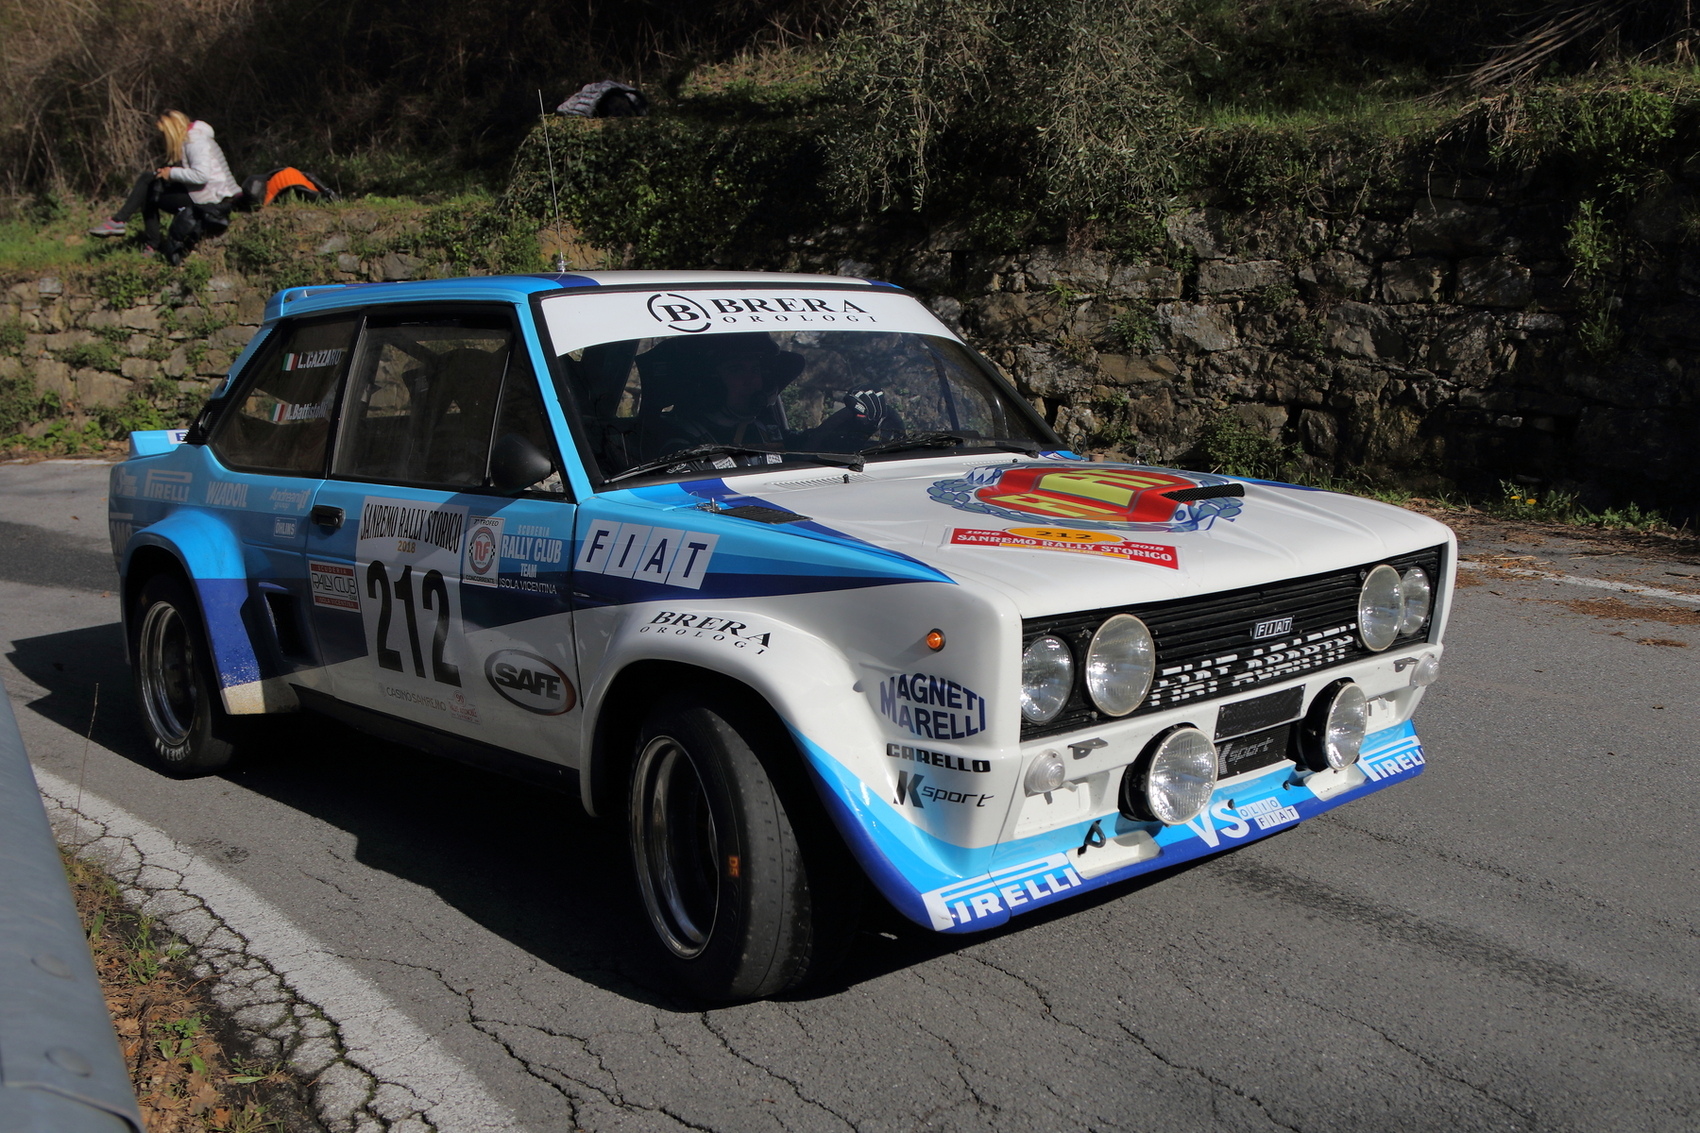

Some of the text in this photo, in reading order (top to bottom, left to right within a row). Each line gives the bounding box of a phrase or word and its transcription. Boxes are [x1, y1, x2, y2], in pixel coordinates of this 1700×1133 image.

[657, 304, 700, 323] B
[710, 297, 868, 314] BRERA
[722, 314, 878, 324] OROLOGI
[143, 469, 193, 502] PIRELLI
[361, 503, 463, 554] SANREMO RALLY STORICO
[517, 524, 551, 537] SCUDERIA
[1036, 530, 1093, 540] 212
[397, 540, 416, 554] 2018
[501, 535, 563, 564] RALLY CLUB
[585, 529, 708, 578] FIAT
[957, 534, 1037, 546] SANREMO
[1042, 540, 1096, 551] RALLY
[1101, 545, 1172, 562] STORICO
[520, 563, 538, 578] TEAM
[499, 577, 557, 595] ISOLA VICENTINA
[367, 560, 462, 688] 212
[650, 611, 772, 649] BRERA
[1256, 619, 1291, 638] FIAT
[640, 626, 765, 655] OROLOGI
[494, 662, 561, 700] SAFE
[880, 673, 986, 713] MAGNETI
[880, 702, 986, 740] MARELLI
[887, 743, 991, 773] CARELLO
[1185, 798, 1250, 848] VS
[1240, 799, 1279, 818] OLIO
[1258, 808, 1296, 827] FIAT
[922, 852, 1082, 932] PIRELLI
